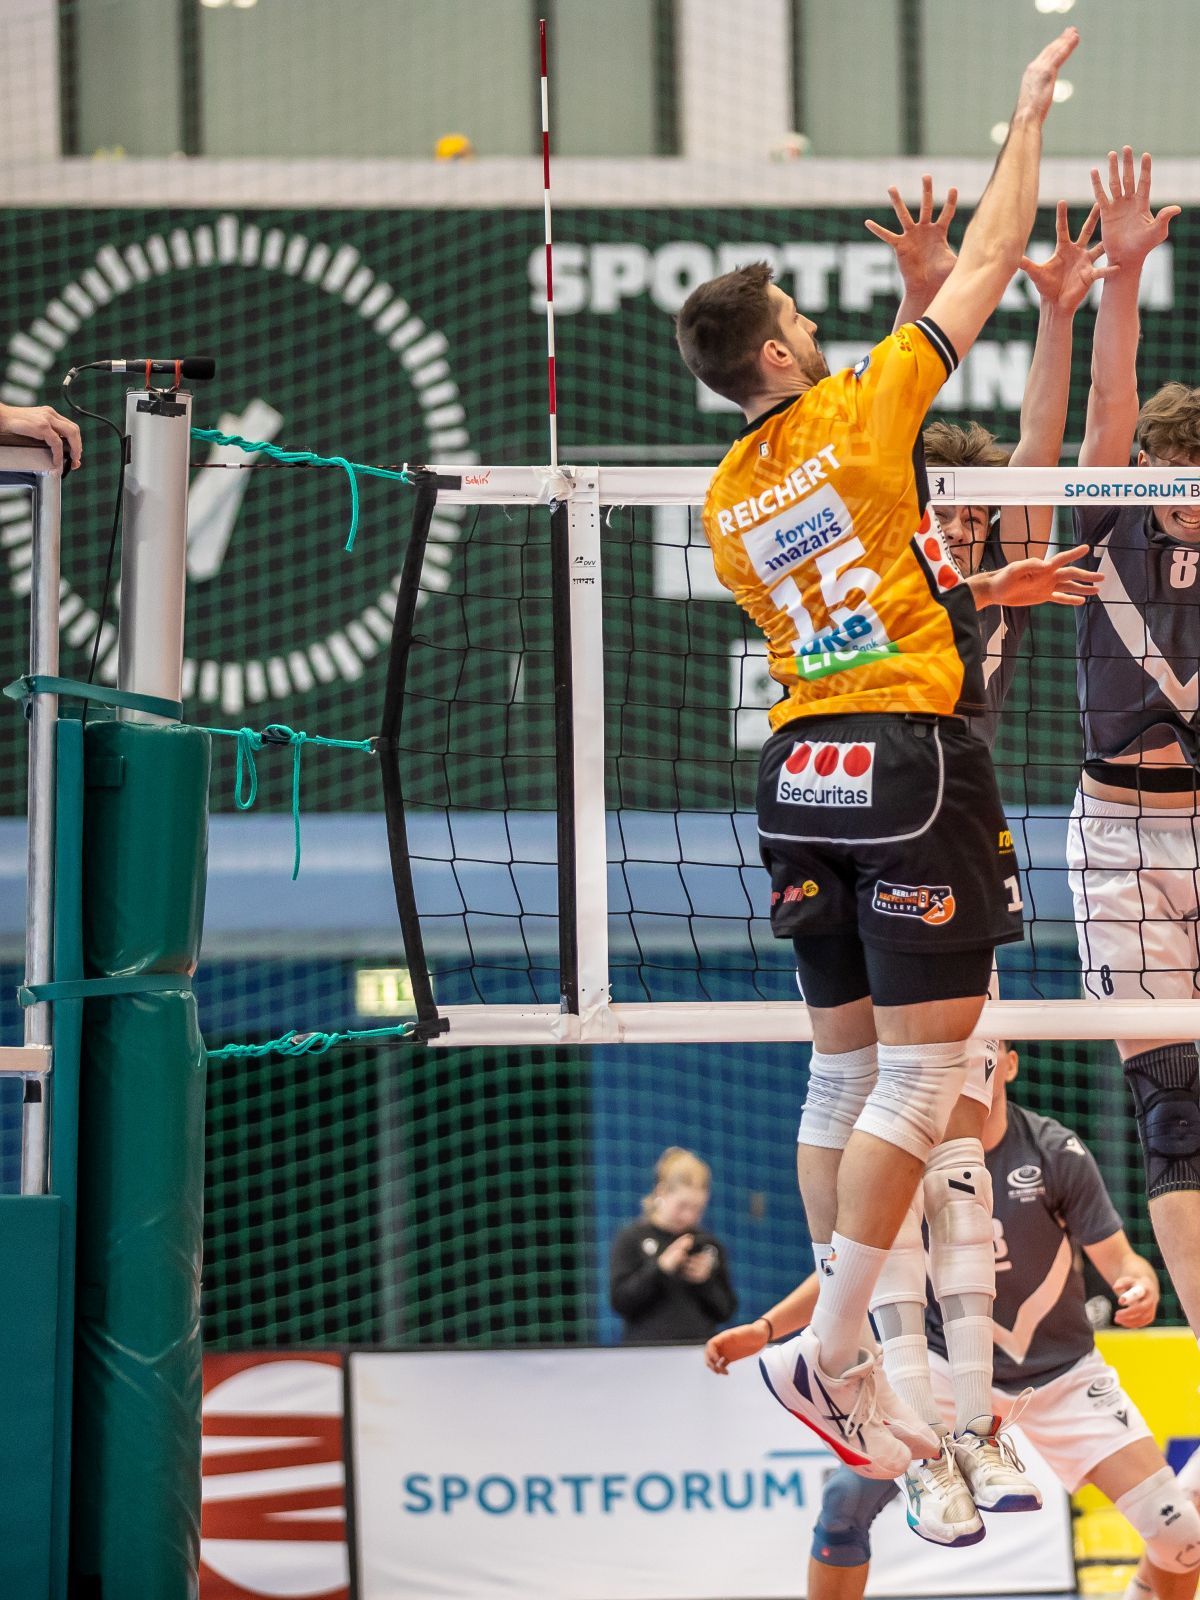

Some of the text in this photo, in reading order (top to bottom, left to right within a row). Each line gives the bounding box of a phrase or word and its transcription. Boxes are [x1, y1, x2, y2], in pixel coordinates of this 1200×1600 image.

[717, 444, 840, 536] REICHERT
[1064, 484, 1186, 498] SPORTFORUM
[765, 520, 842, 571] mazars
[774, 506, 835, 549] forvis
[1169, 546, 1200, 589] 8
[769, 536, 881, 655] 15
[779, 782, 869, 805] Securitas
[1100, 964, 1115, 996] 8
[402, 1470, 805, 1516] SPORTFORUM
